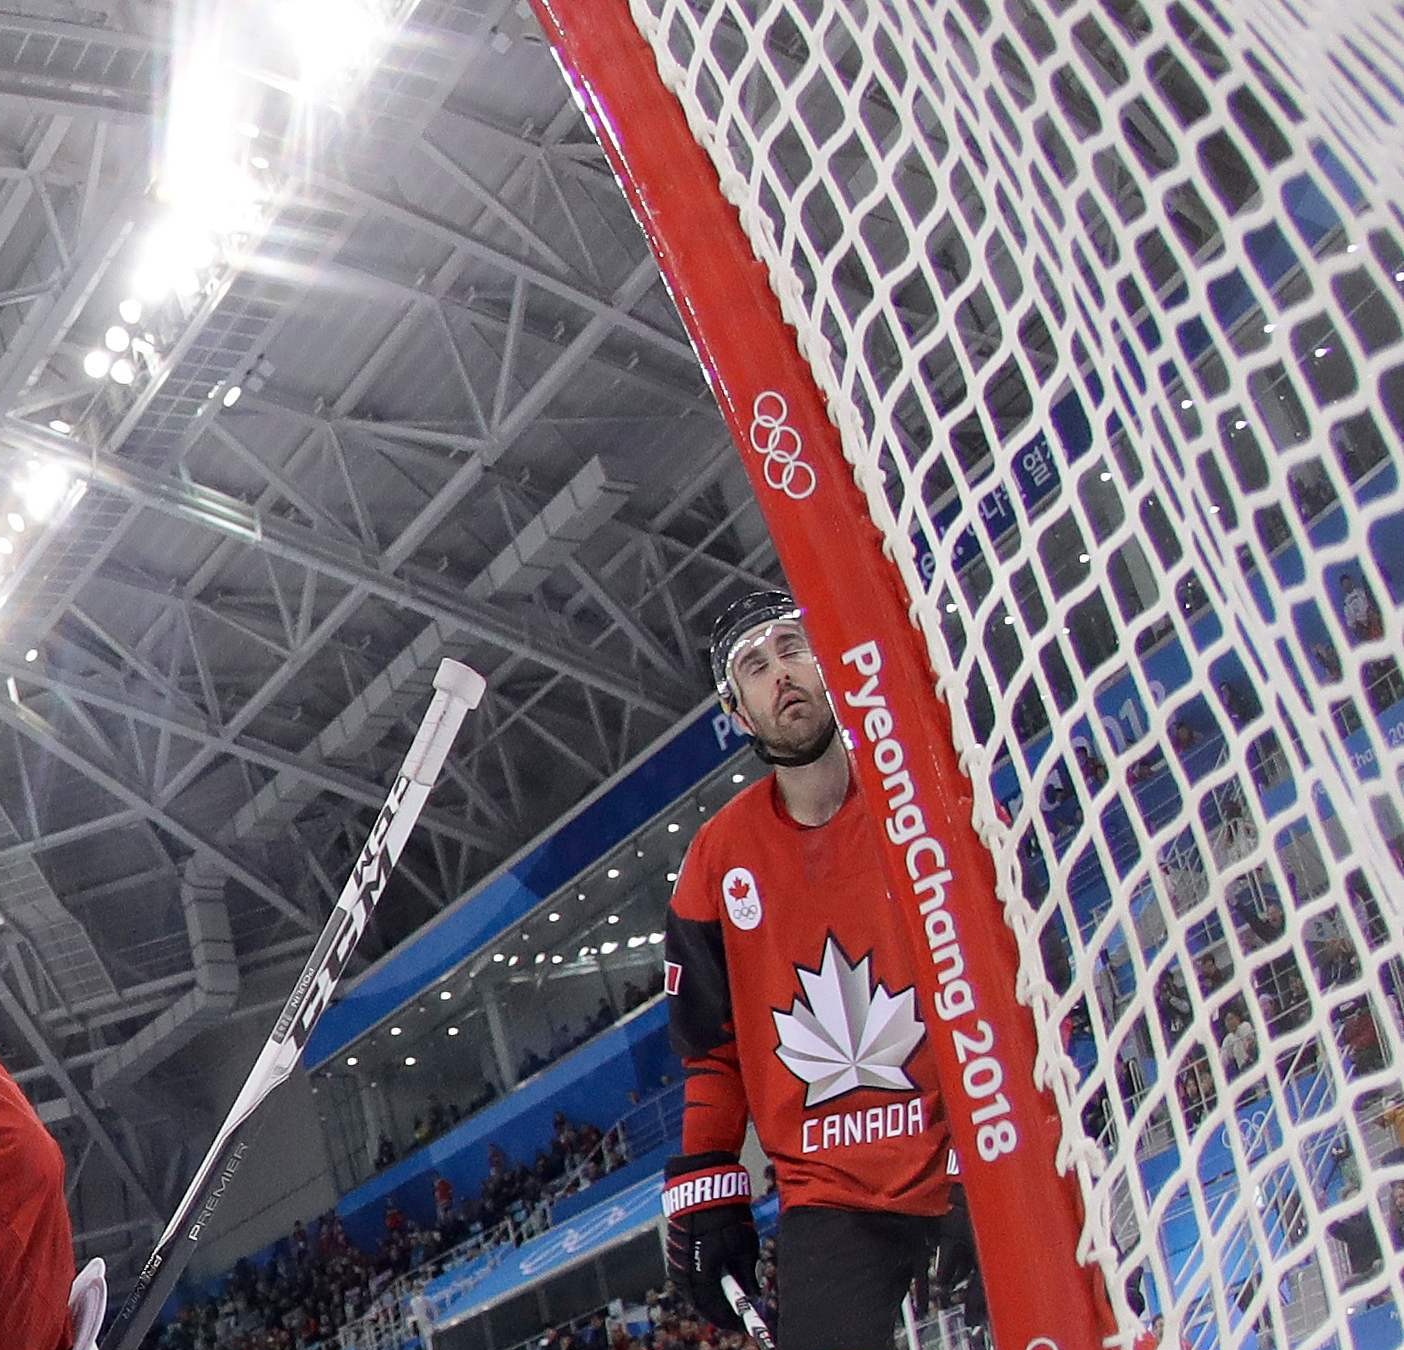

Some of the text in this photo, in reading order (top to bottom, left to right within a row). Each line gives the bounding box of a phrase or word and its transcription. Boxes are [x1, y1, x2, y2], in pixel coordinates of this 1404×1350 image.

[842, 640, 1019, 1164] PyeongChang 2018
[802, 1097, 924, 1153] CANADA
[188, 1141, 249, 1241] PREMIER
